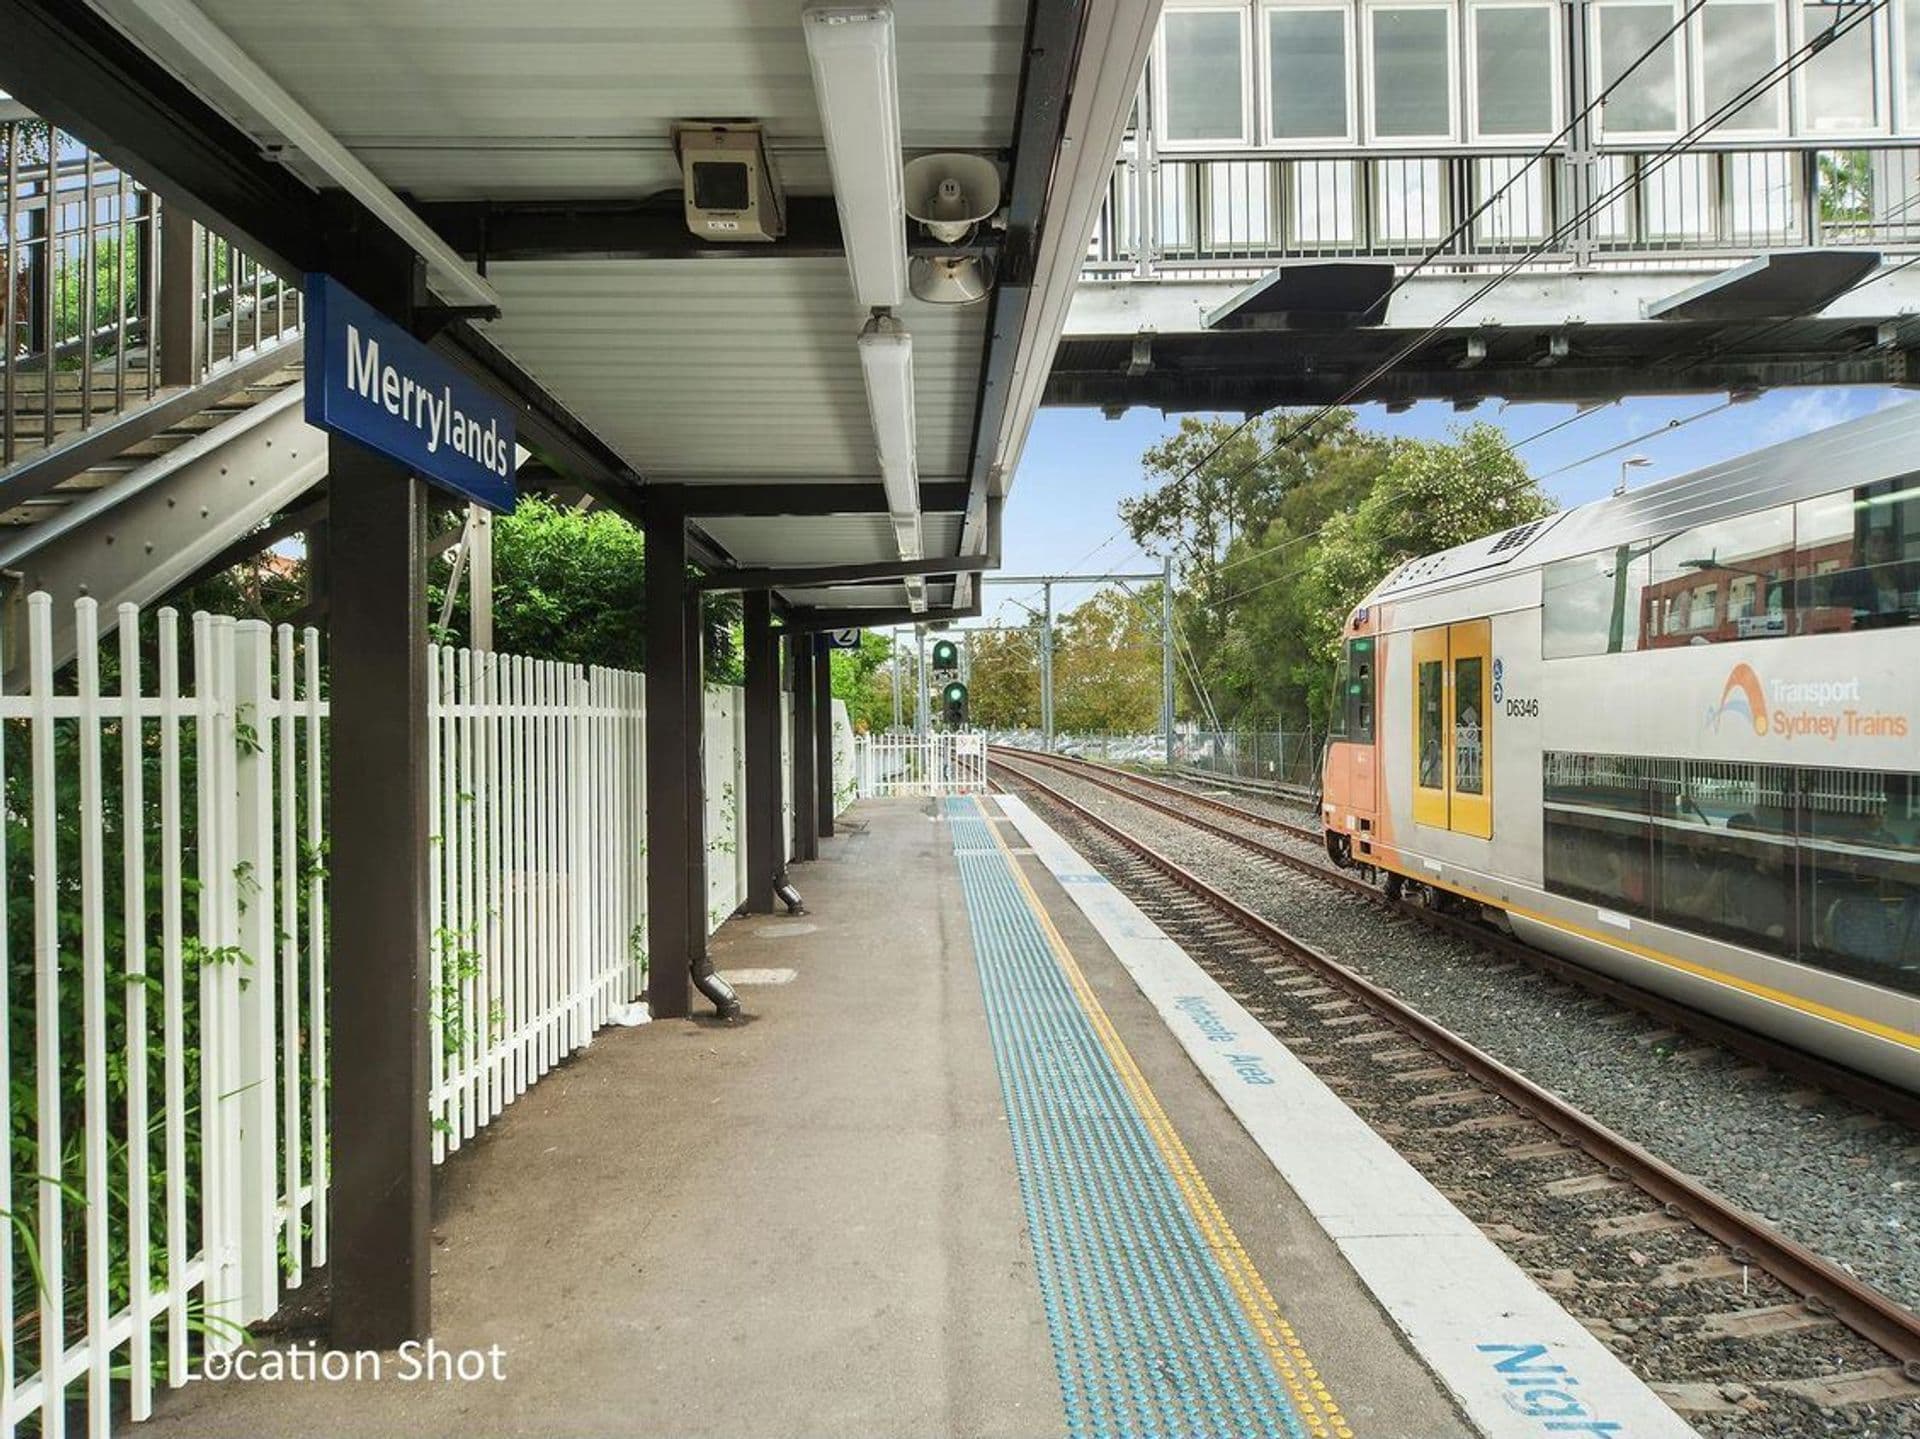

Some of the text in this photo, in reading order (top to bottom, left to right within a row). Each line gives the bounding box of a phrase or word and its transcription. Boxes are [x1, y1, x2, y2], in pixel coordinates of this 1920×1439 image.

[346, 323, 508, 478] Merrylands
[1507, 698, 1539, 717] D6346
[1770, 676, 1860, 707] Transport
[1772, 709, 1909, 741] Sydney Trains
[1223, 1053, 1276, 1085] Area
